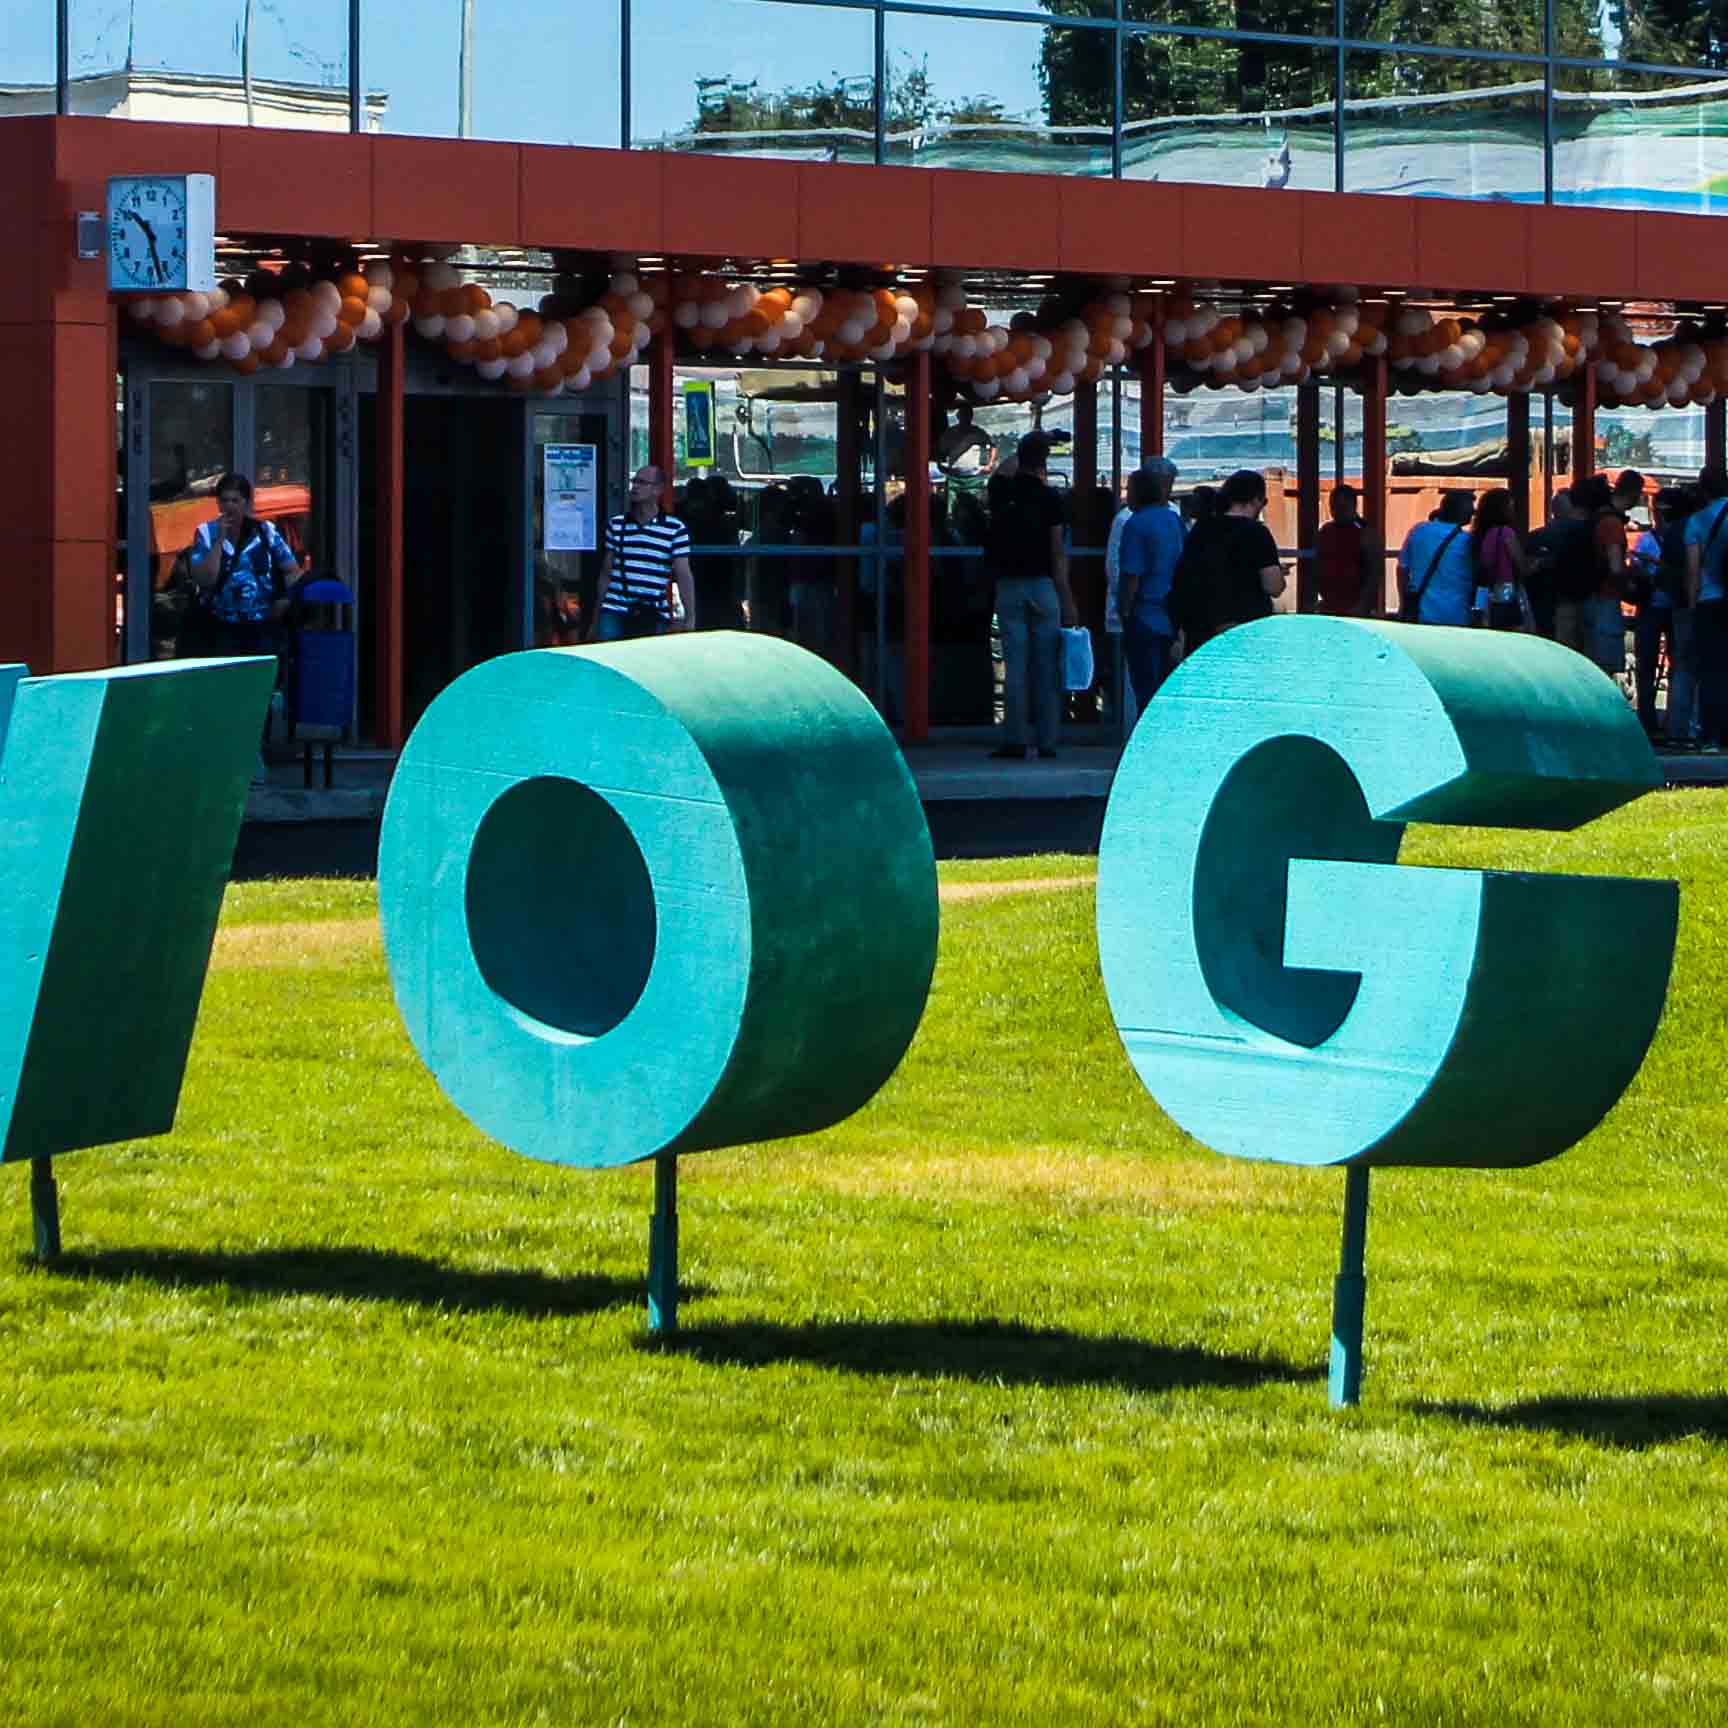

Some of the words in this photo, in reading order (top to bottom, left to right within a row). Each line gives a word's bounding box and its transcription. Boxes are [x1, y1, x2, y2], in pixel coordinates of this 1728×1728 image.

[146, 190, 157, 201] 12
[132, 196, 141, 207] 11
[172, 209, 178, 220] 2
[135, 261, 141, 272] 7
